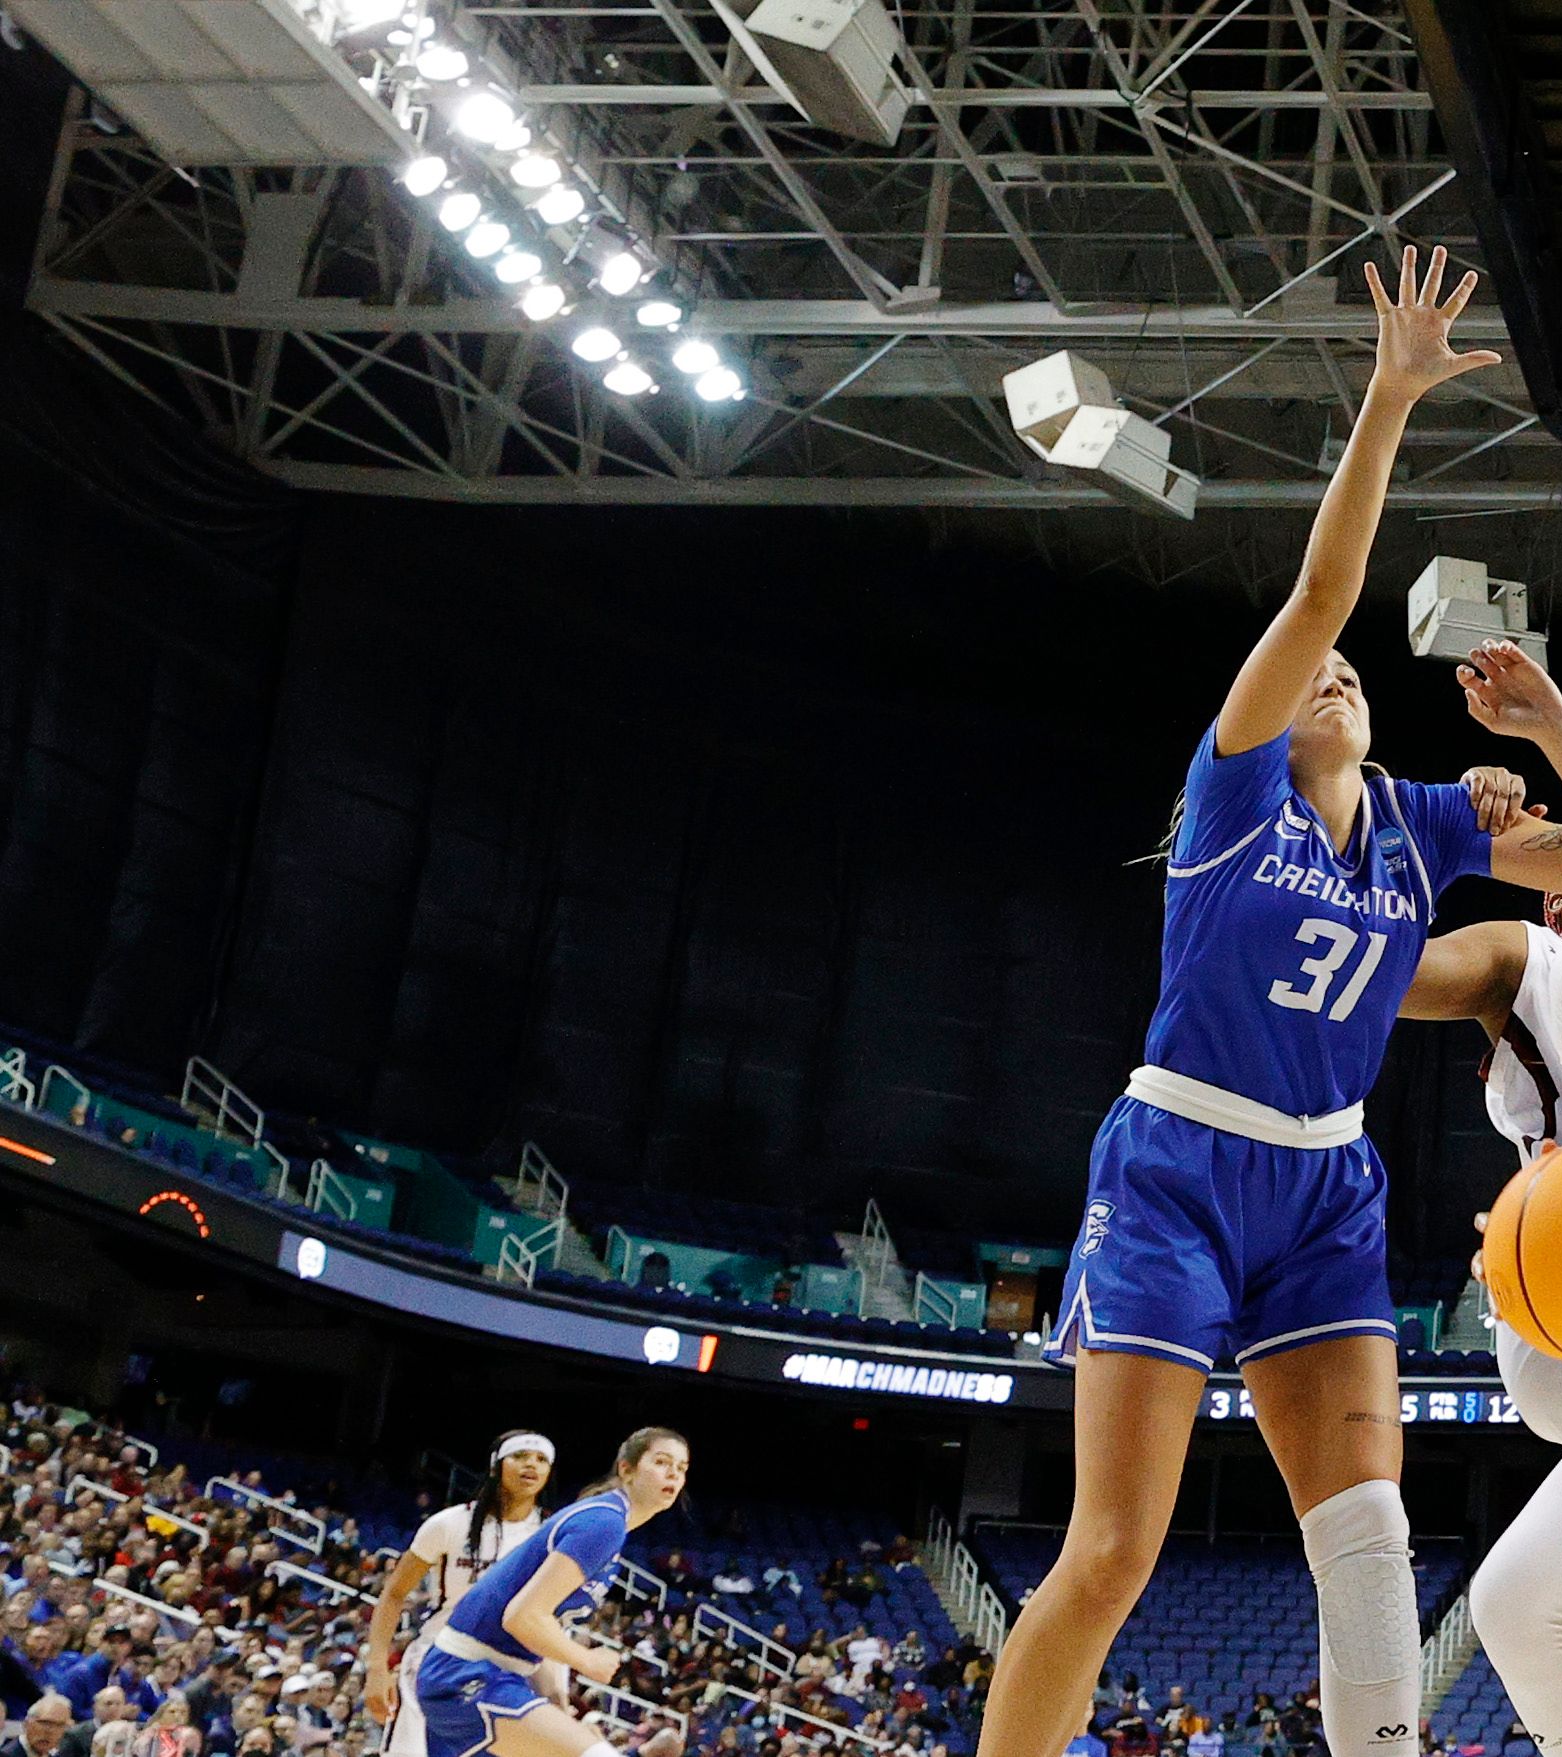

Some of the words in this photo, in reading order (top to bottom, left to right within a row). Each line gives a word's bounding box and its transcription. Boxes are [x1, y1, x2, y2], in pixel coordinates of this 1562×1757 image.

[1253, 854, 1418, 922] CREIGHTON
[1268, 918, 1388, 1022] 31
[783, 1354, 1013, 1403] #MARCHMADNESS
[1210, 1391, 1230, 1419] 3
[1400, 1395, 1418, 1422] 5
[1488, 1396, 1520, 1423] 12
